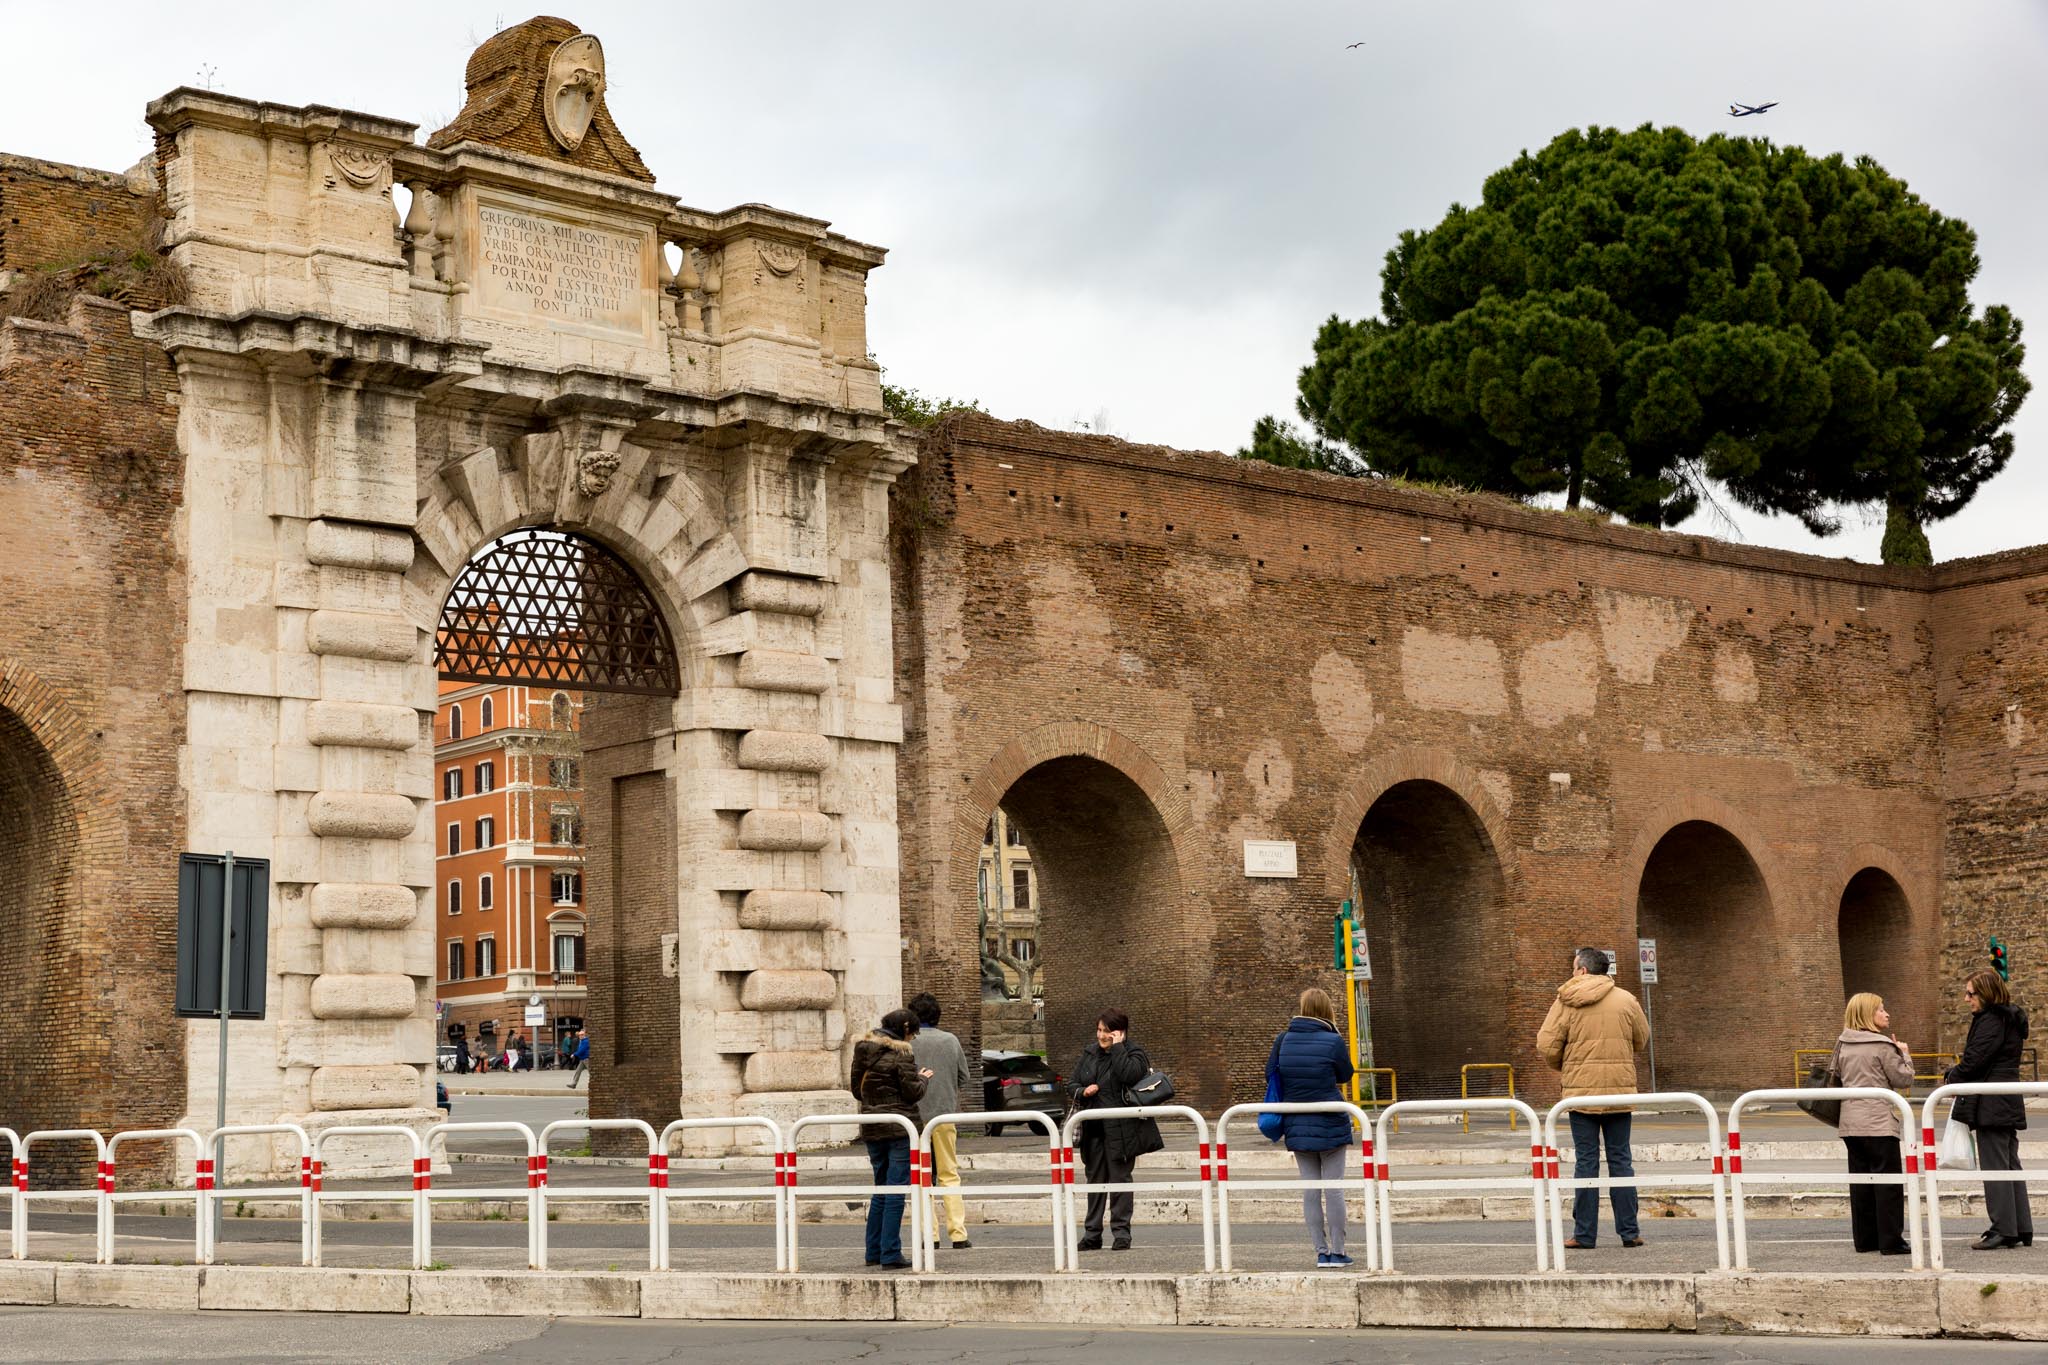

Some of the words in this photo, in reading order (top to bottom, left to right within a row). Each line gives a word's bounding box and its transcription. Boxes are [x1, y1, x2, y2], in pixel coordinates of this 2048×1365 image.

[486, 225, 548, 246] PVBLICAE
[555, 238, 614, 261] VTILITATI
[620, 252, 634, 265] ET
[579, 231, 608, 246] PONT
[615, 239, 639, 253] MAX
[484, 237, 518, 253] VRBIS
[525, 245, 601, 270] ORNAMENTO
[609, 262, 637, 278] VIAM
[485, 250, 552, 272] CAMPANAM
[492, 264, 548, 284] PORTAM
[558, 277, 630, 302] EXSTRVXIT
[505, 281, 543, 296] ANNO
[534, 298, 569, 314] PONT
